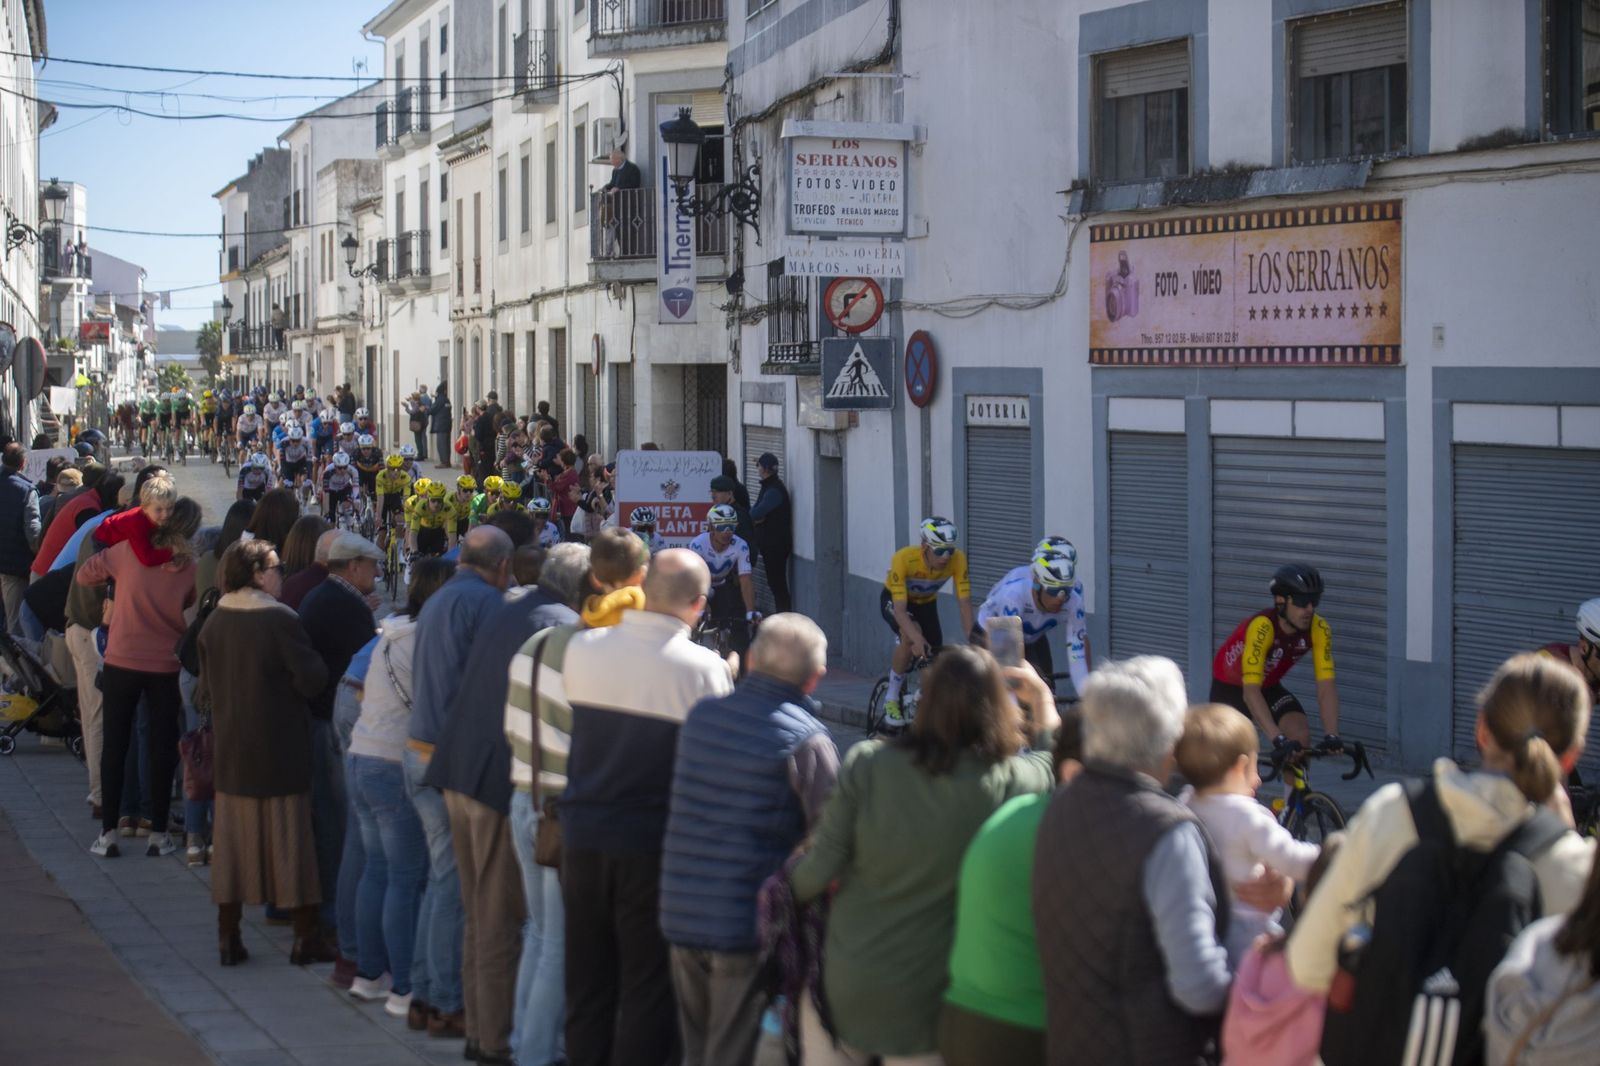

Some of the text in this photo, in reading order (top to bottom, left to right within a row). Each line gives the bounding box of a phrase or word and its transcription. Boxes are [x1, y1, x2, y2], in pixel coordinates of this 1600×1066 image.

[832, 139, 860, 150] LOS
[796, 153, 898, 169] SERRANOS
[794, 203, 899, 217] TROFEOS REGALOS MARCOS
[788, 260, 840, 273] MARCOS
[1248, 244, 1390, 295] LOS SERRANOS
[1154, 271, 1179, 297] FOTO
[1192, 263, 1222, 296] VÍDEO
[970, 402, 1027, 419] JOYERIA
[655, 520, 708, 533] LANTE
[1247, 622, 1270, 665] Cofidis
